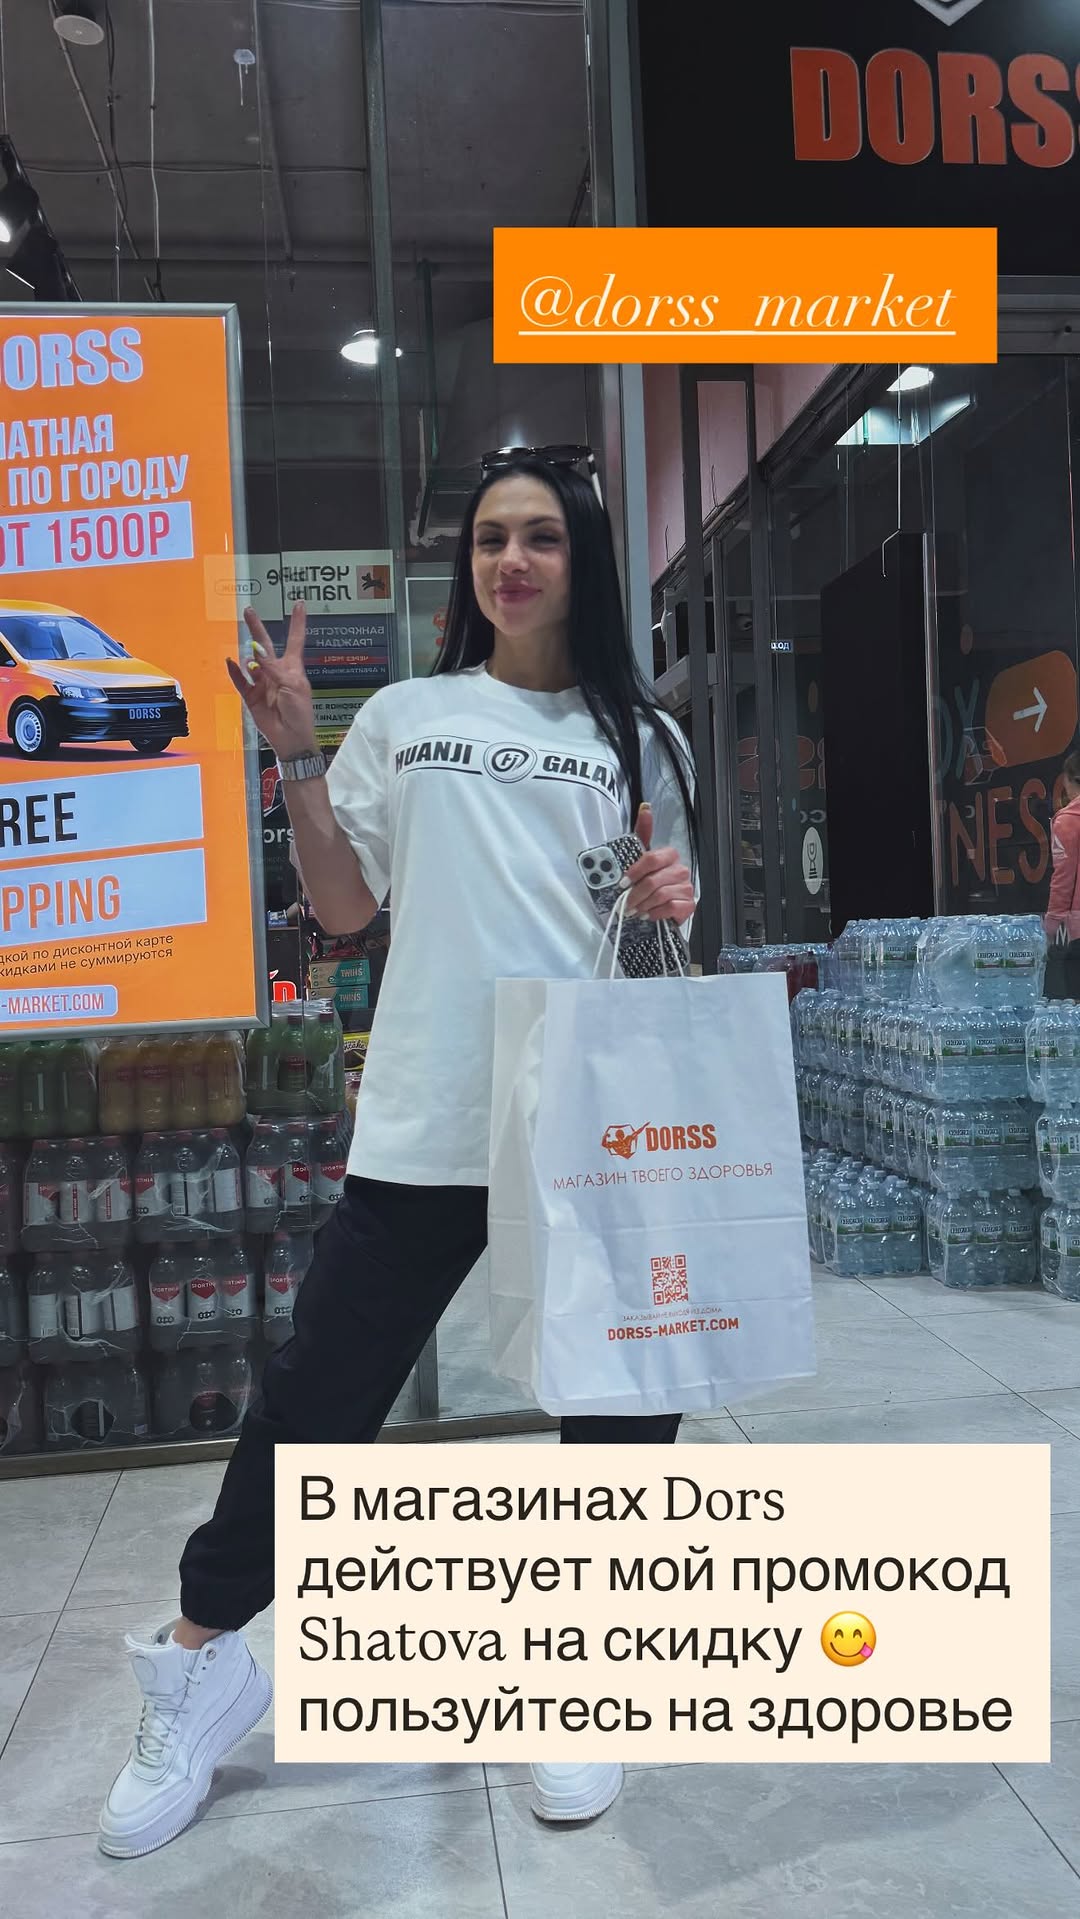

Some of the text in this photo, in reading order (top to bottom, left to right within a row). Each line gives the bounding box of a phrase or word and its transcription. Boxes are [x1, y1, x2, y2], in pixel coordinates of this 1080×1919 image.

[790, 46, 1080, 168] DORS
[0, 327, 143, 391] ORSS
[8, 454, 189, 506] ПО ГОРОДУ
[48, 510, 170, 563] 1500Р
[129, 708, 161, 719] DORSS
[395, 741, 473, 775] HUANJI
[33, 950, 49, 959] по
[53, 939, 132, 958] дисконтной
[136, 935, 174, 949] карте
[61, 960, 76, 970] не
[81, 949, 173, 970] суммируются
[646, 1123, 717, 1152] DORSS
[553, 1162, 773, 1190] МАГАЗИН ТВОЕГО ЗДОРОВЬЯ
[608, 1317, 739, 1341] DORSS-MARKET.COM
